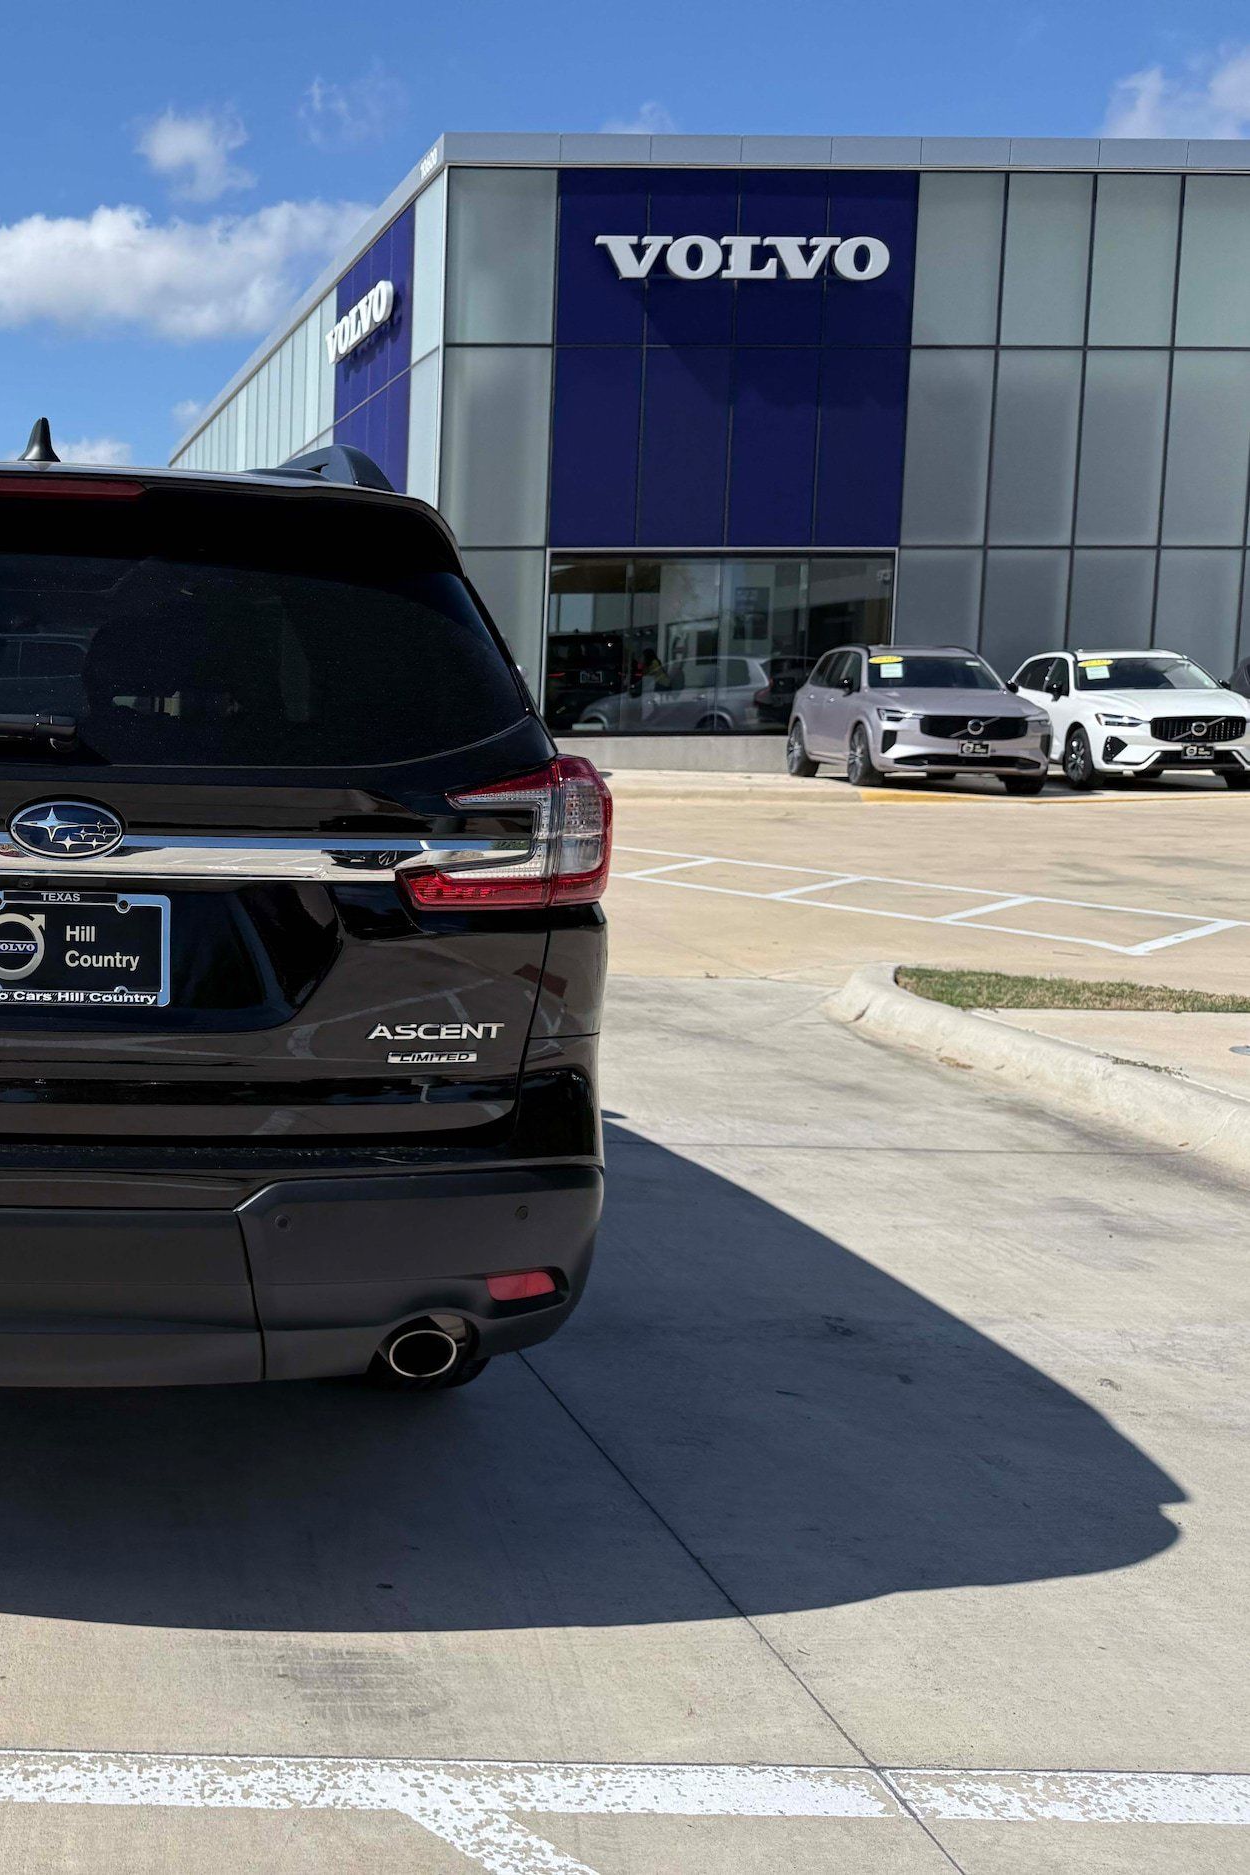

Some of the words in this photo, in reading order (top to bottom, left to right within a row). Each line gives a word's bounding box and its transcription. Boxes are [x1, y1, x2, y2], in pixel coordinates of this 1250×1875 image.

[595, 235, 890, 281] VOLVO
[325, 280, 393, 364] VOLVO
[41, 892, 81, 902] TEXAS
[65, 925, 96, 942] Hill
[65, 950, 140, 971] Country
[13, 991, 51, 1001] Cars
[57, 992, 84, 1002] Hill
[89, 993, 156, 1005] Country
[368, 1022, 505, 1040] ASCENT
[400, 1052, 470, 1062] LIMITED
